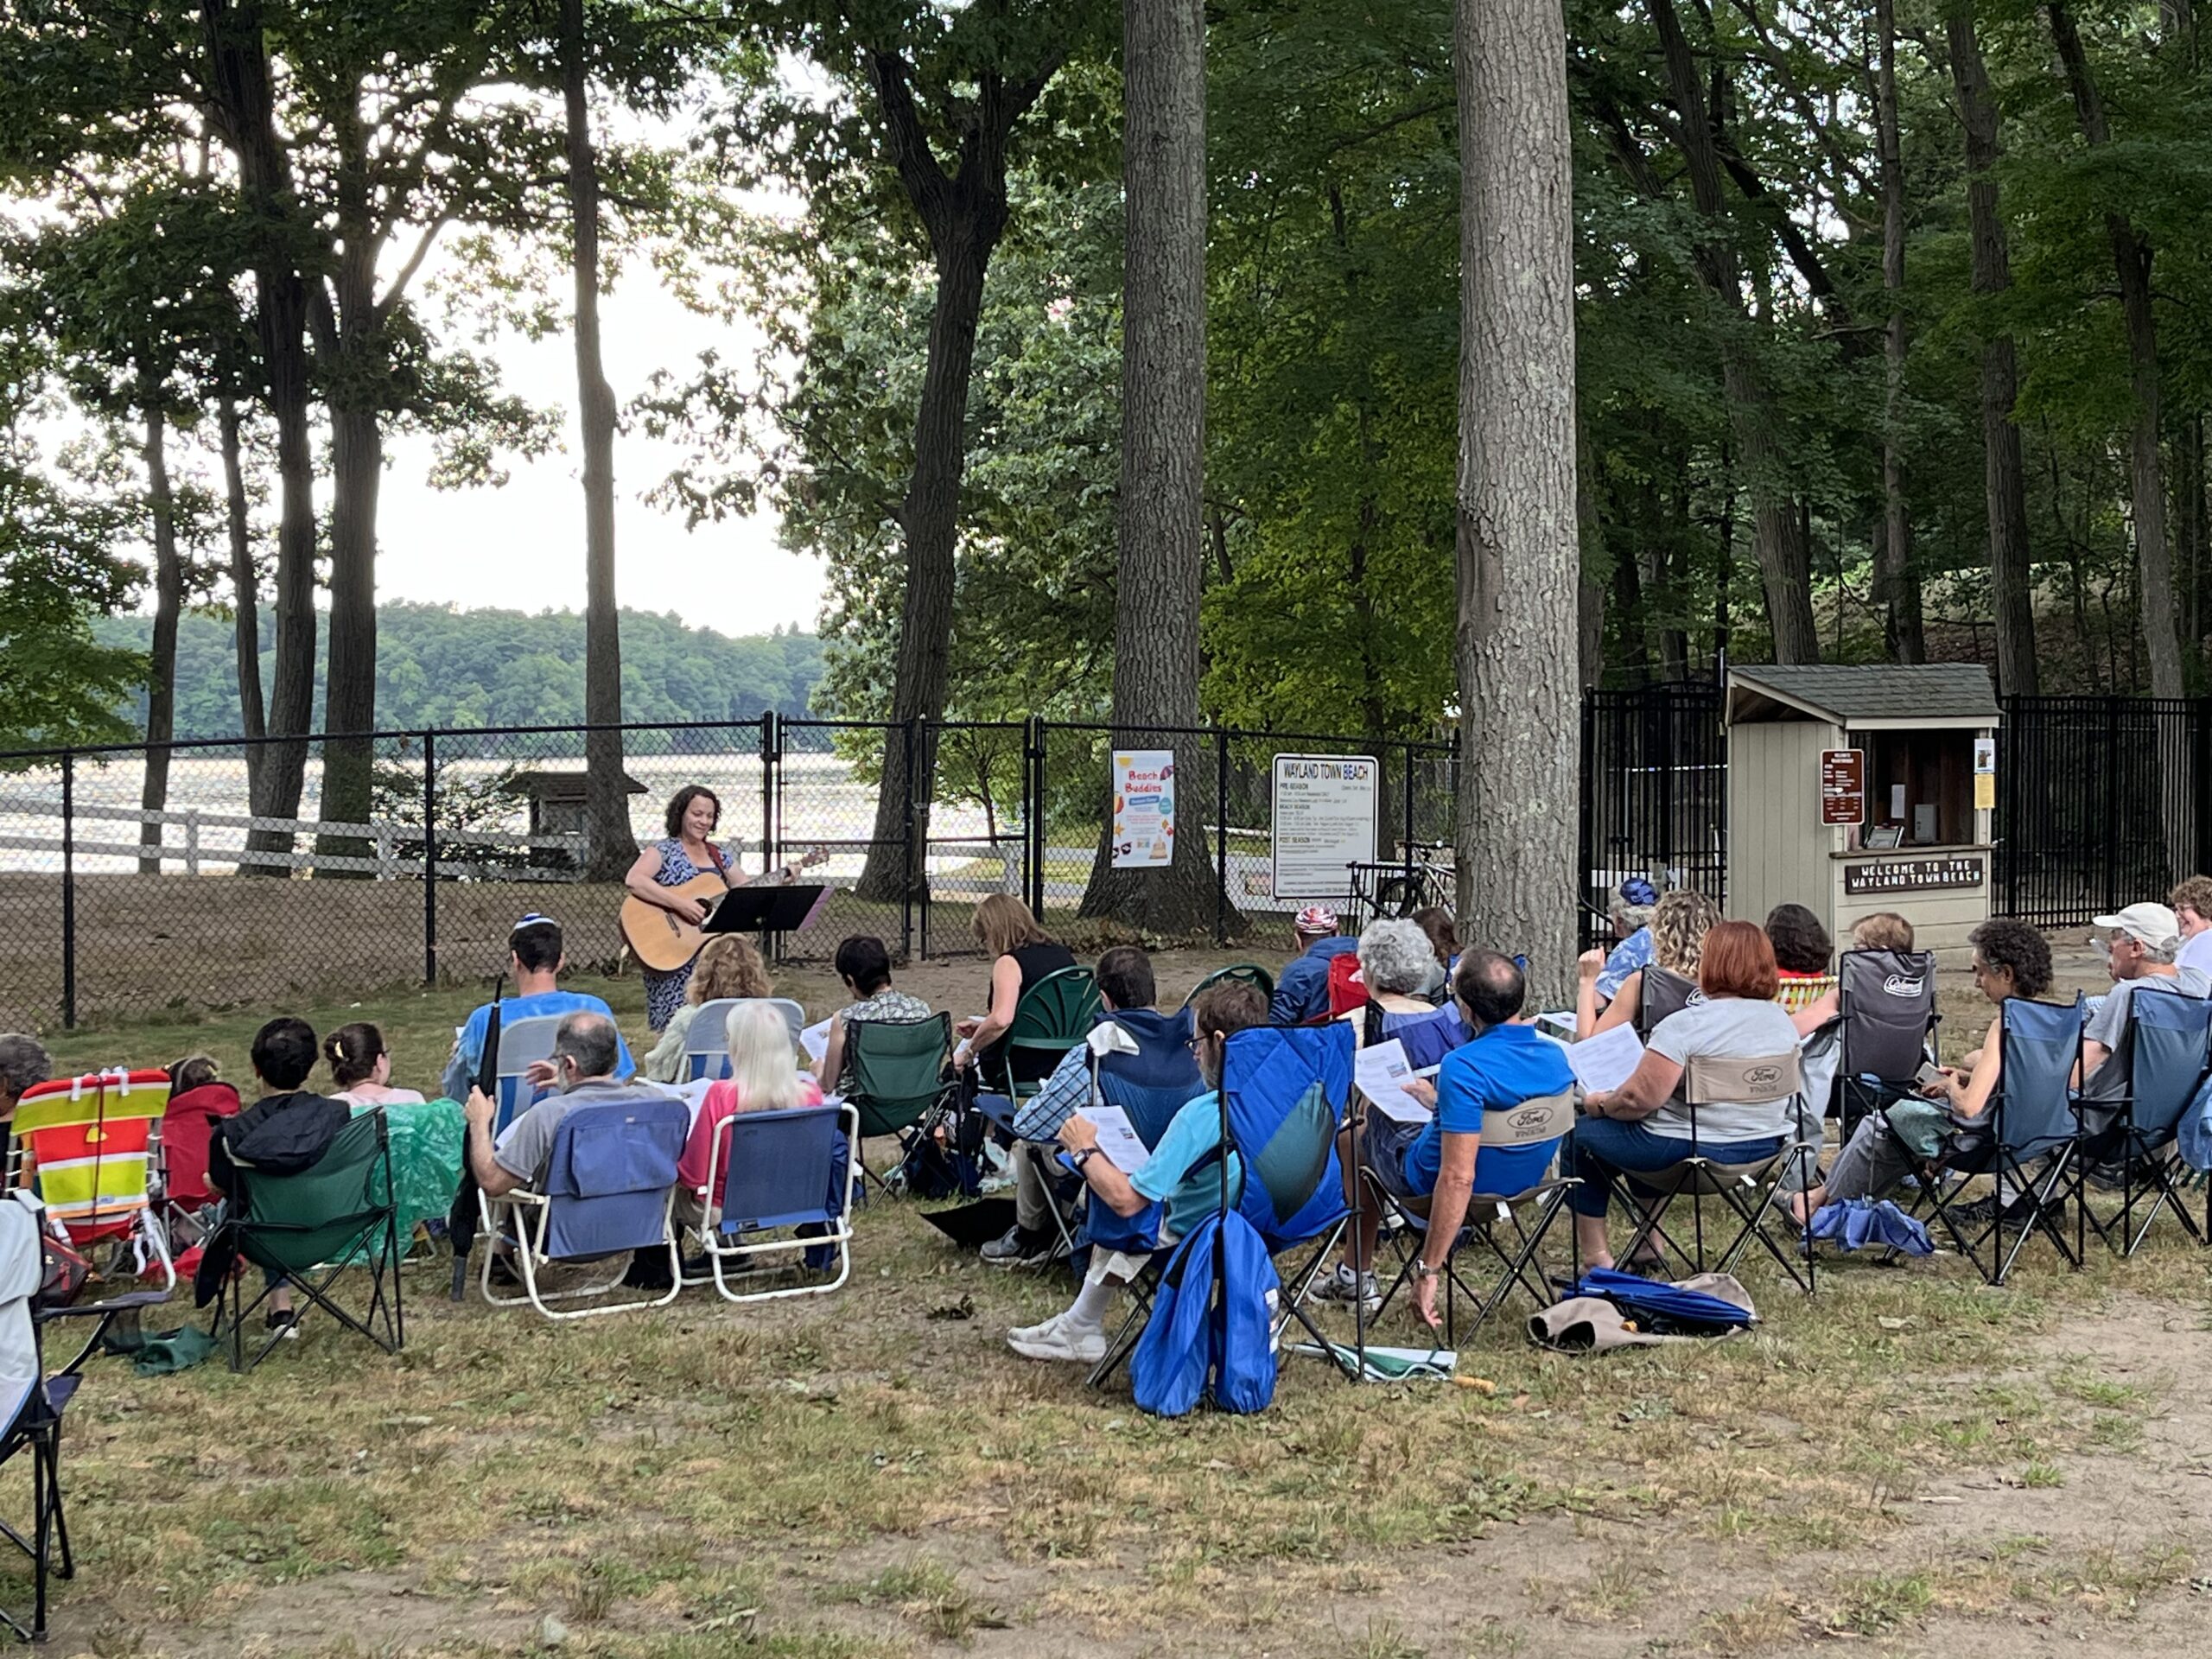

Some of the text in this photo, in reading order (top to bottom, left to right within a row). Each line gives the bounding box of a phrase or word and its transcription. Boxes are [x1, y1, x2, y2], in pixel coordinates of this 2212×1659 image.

[1128, 770, 1158, 780] Beach
[1284, 762, 1369, 780] WAYLAND TOWN BEACH
[1125, 783, 1162, 792] Buddies
[1861, 860, 1970, 876] WELCOME TO THE
[1851, 871, 1980, 888] WAYLAND TOWN BEACH
[1751, 1068, 1777, 1082] Ford
[1516, 1109, 1547, 1126] Ford
